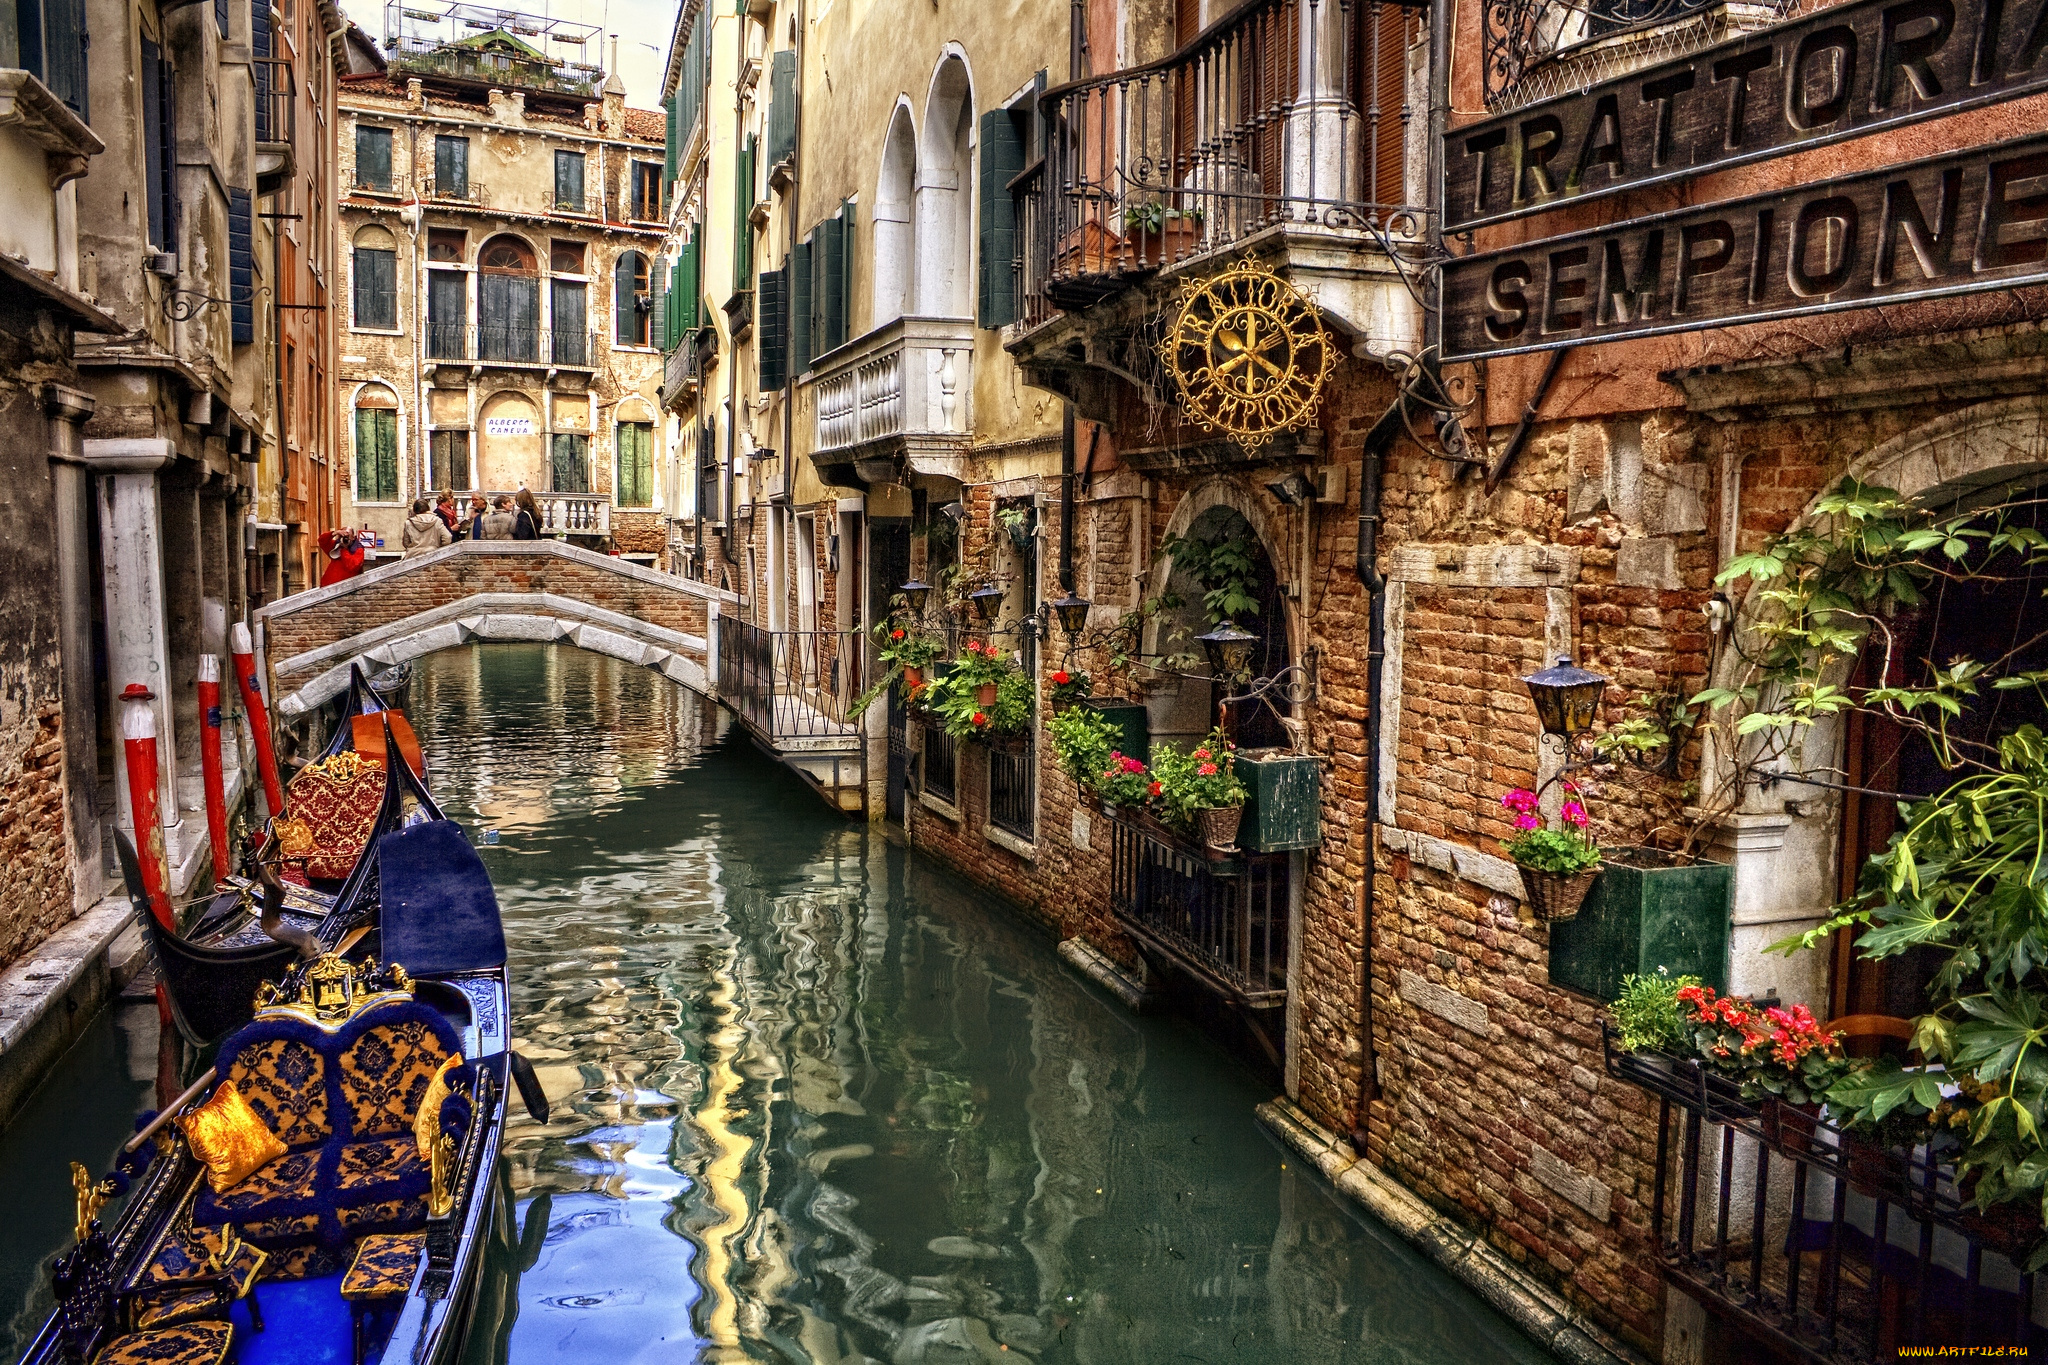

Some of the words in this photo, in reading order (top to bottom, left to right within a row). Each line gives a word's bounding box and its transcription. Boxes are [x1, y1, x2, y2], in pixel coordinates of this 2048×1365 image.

[1484, 153, 2048, 342] SEMPIONE
[1177, 275, 1324, 355] TRATTORIA
[1178, 364, 1320, 432] SEMPIONE
